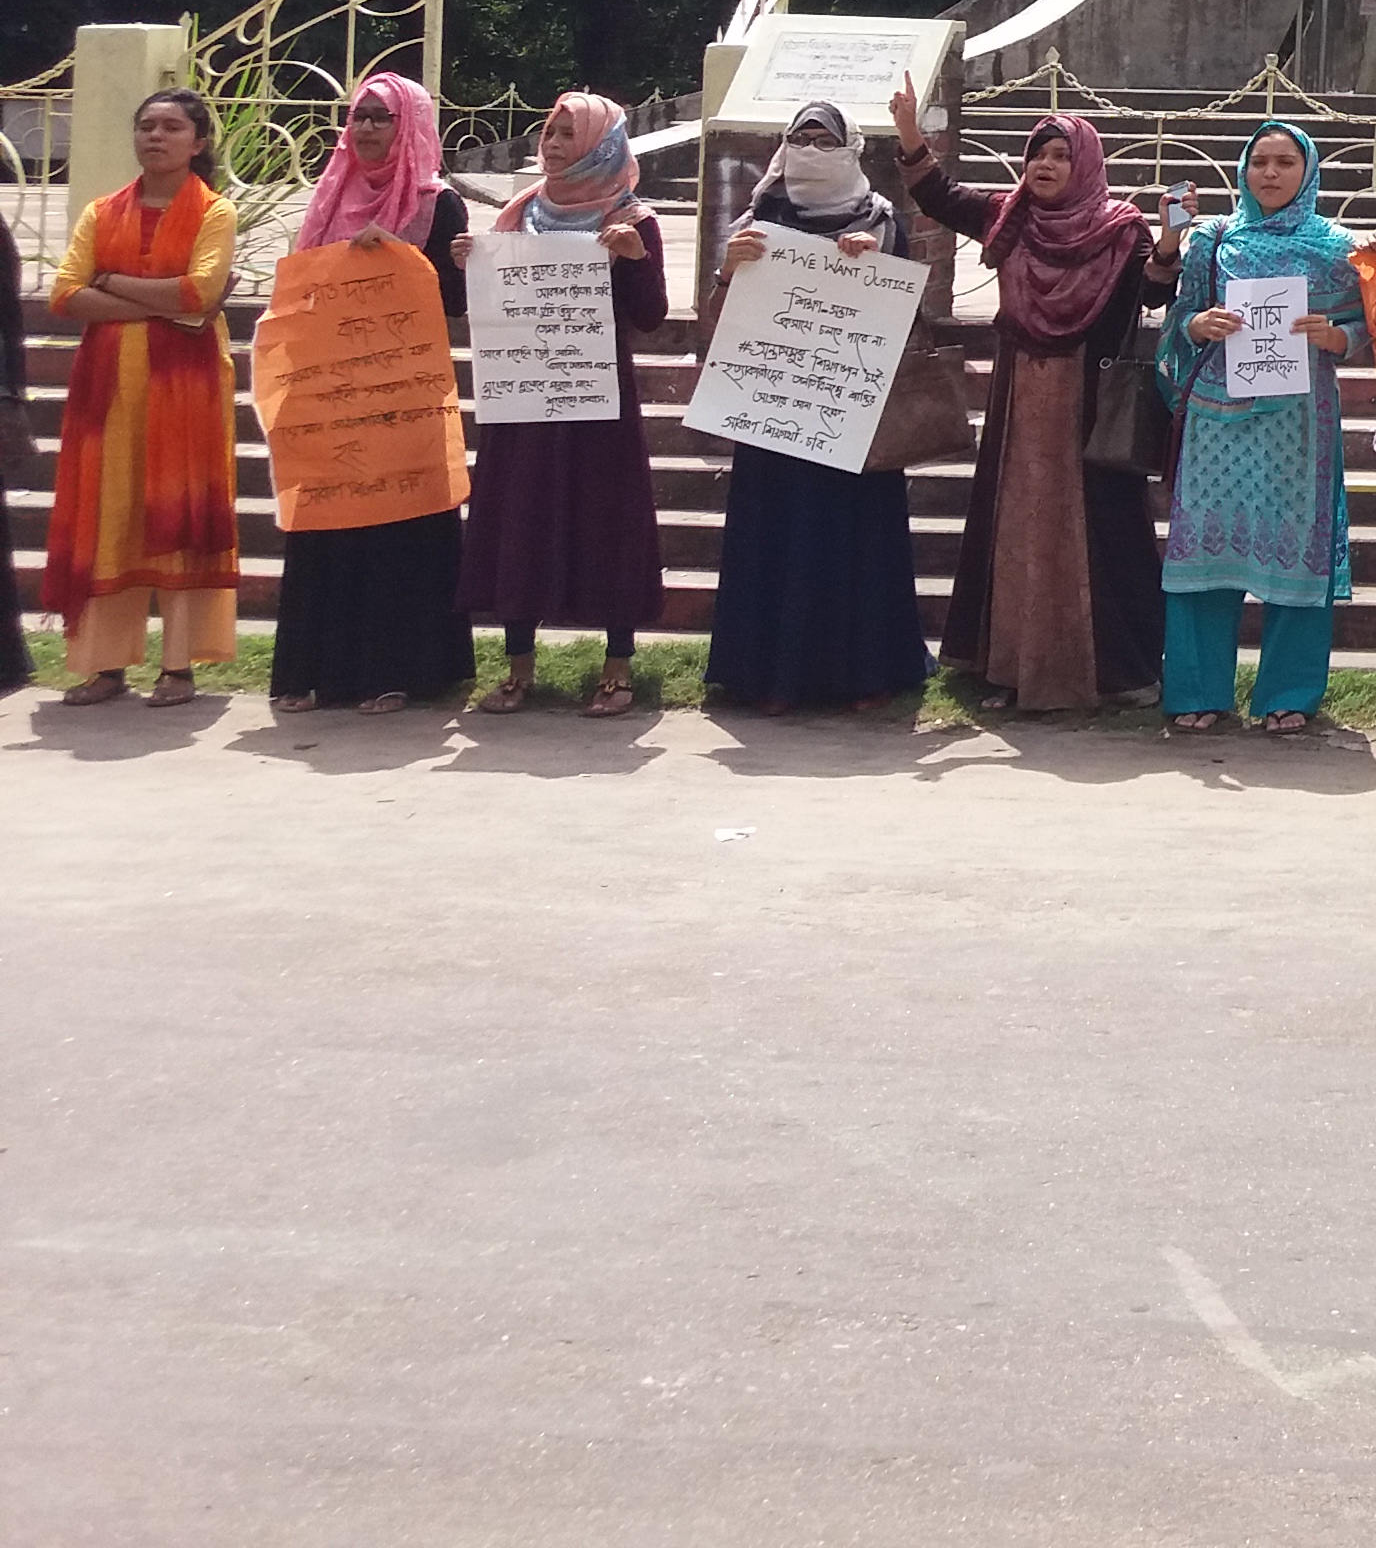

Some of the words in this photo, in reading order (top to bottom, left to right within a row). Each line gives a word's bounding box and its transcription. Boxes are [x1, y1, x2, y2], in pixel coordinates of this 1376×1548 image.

[823, 255, 861, 278] WANT
[864, 265, 916, 294] JUSTICE
[1251, 332, 1286, 358] চাই
